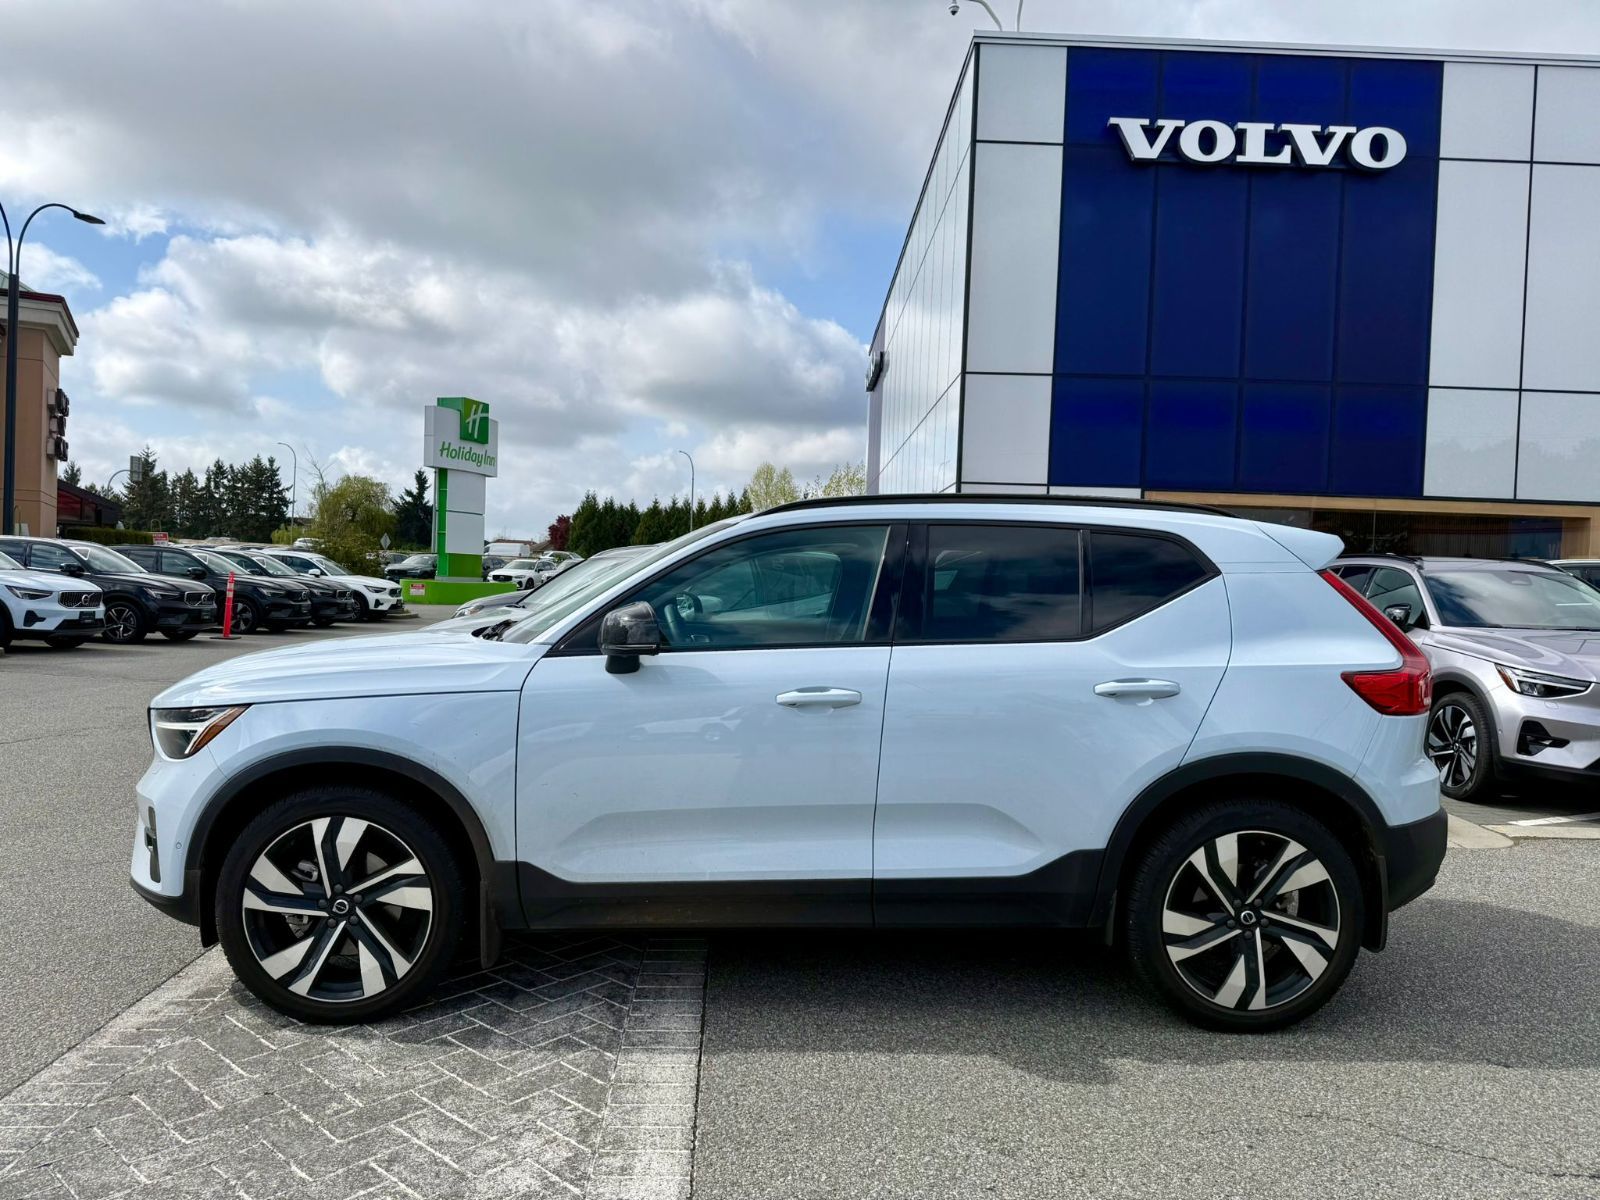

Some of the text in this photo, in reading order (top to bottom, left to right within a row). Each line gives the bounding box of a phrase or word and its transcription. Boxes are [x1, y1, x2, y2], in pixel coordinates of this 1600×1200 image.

[1107, 116, 1408, 170] VOLVO
[439, 441, 496, 467] Holiday Inn
